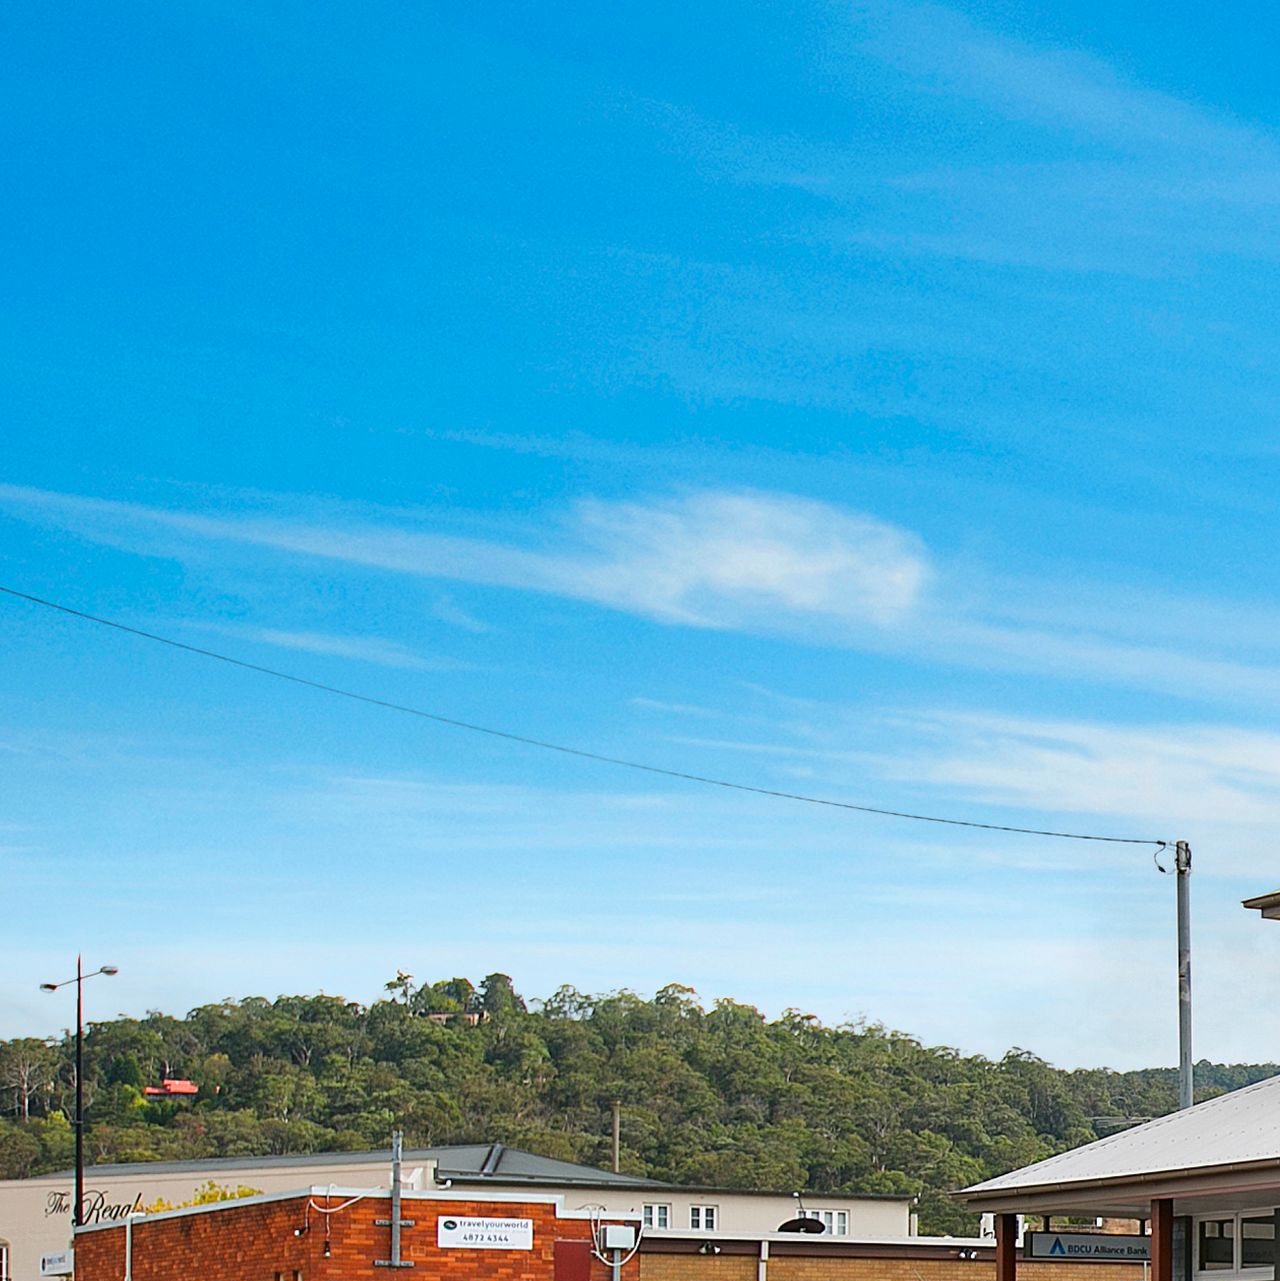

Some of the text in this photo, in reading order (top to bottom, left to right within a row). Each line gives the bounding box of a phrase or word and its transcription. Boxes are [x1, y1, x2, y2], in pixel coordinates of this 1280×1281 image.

[45, 1191, 70, 1218] The
[460, 1220, 528, 1229] travelyourworld
[1068, 1244, 1147, 1255] BDCU Alliance Bank
